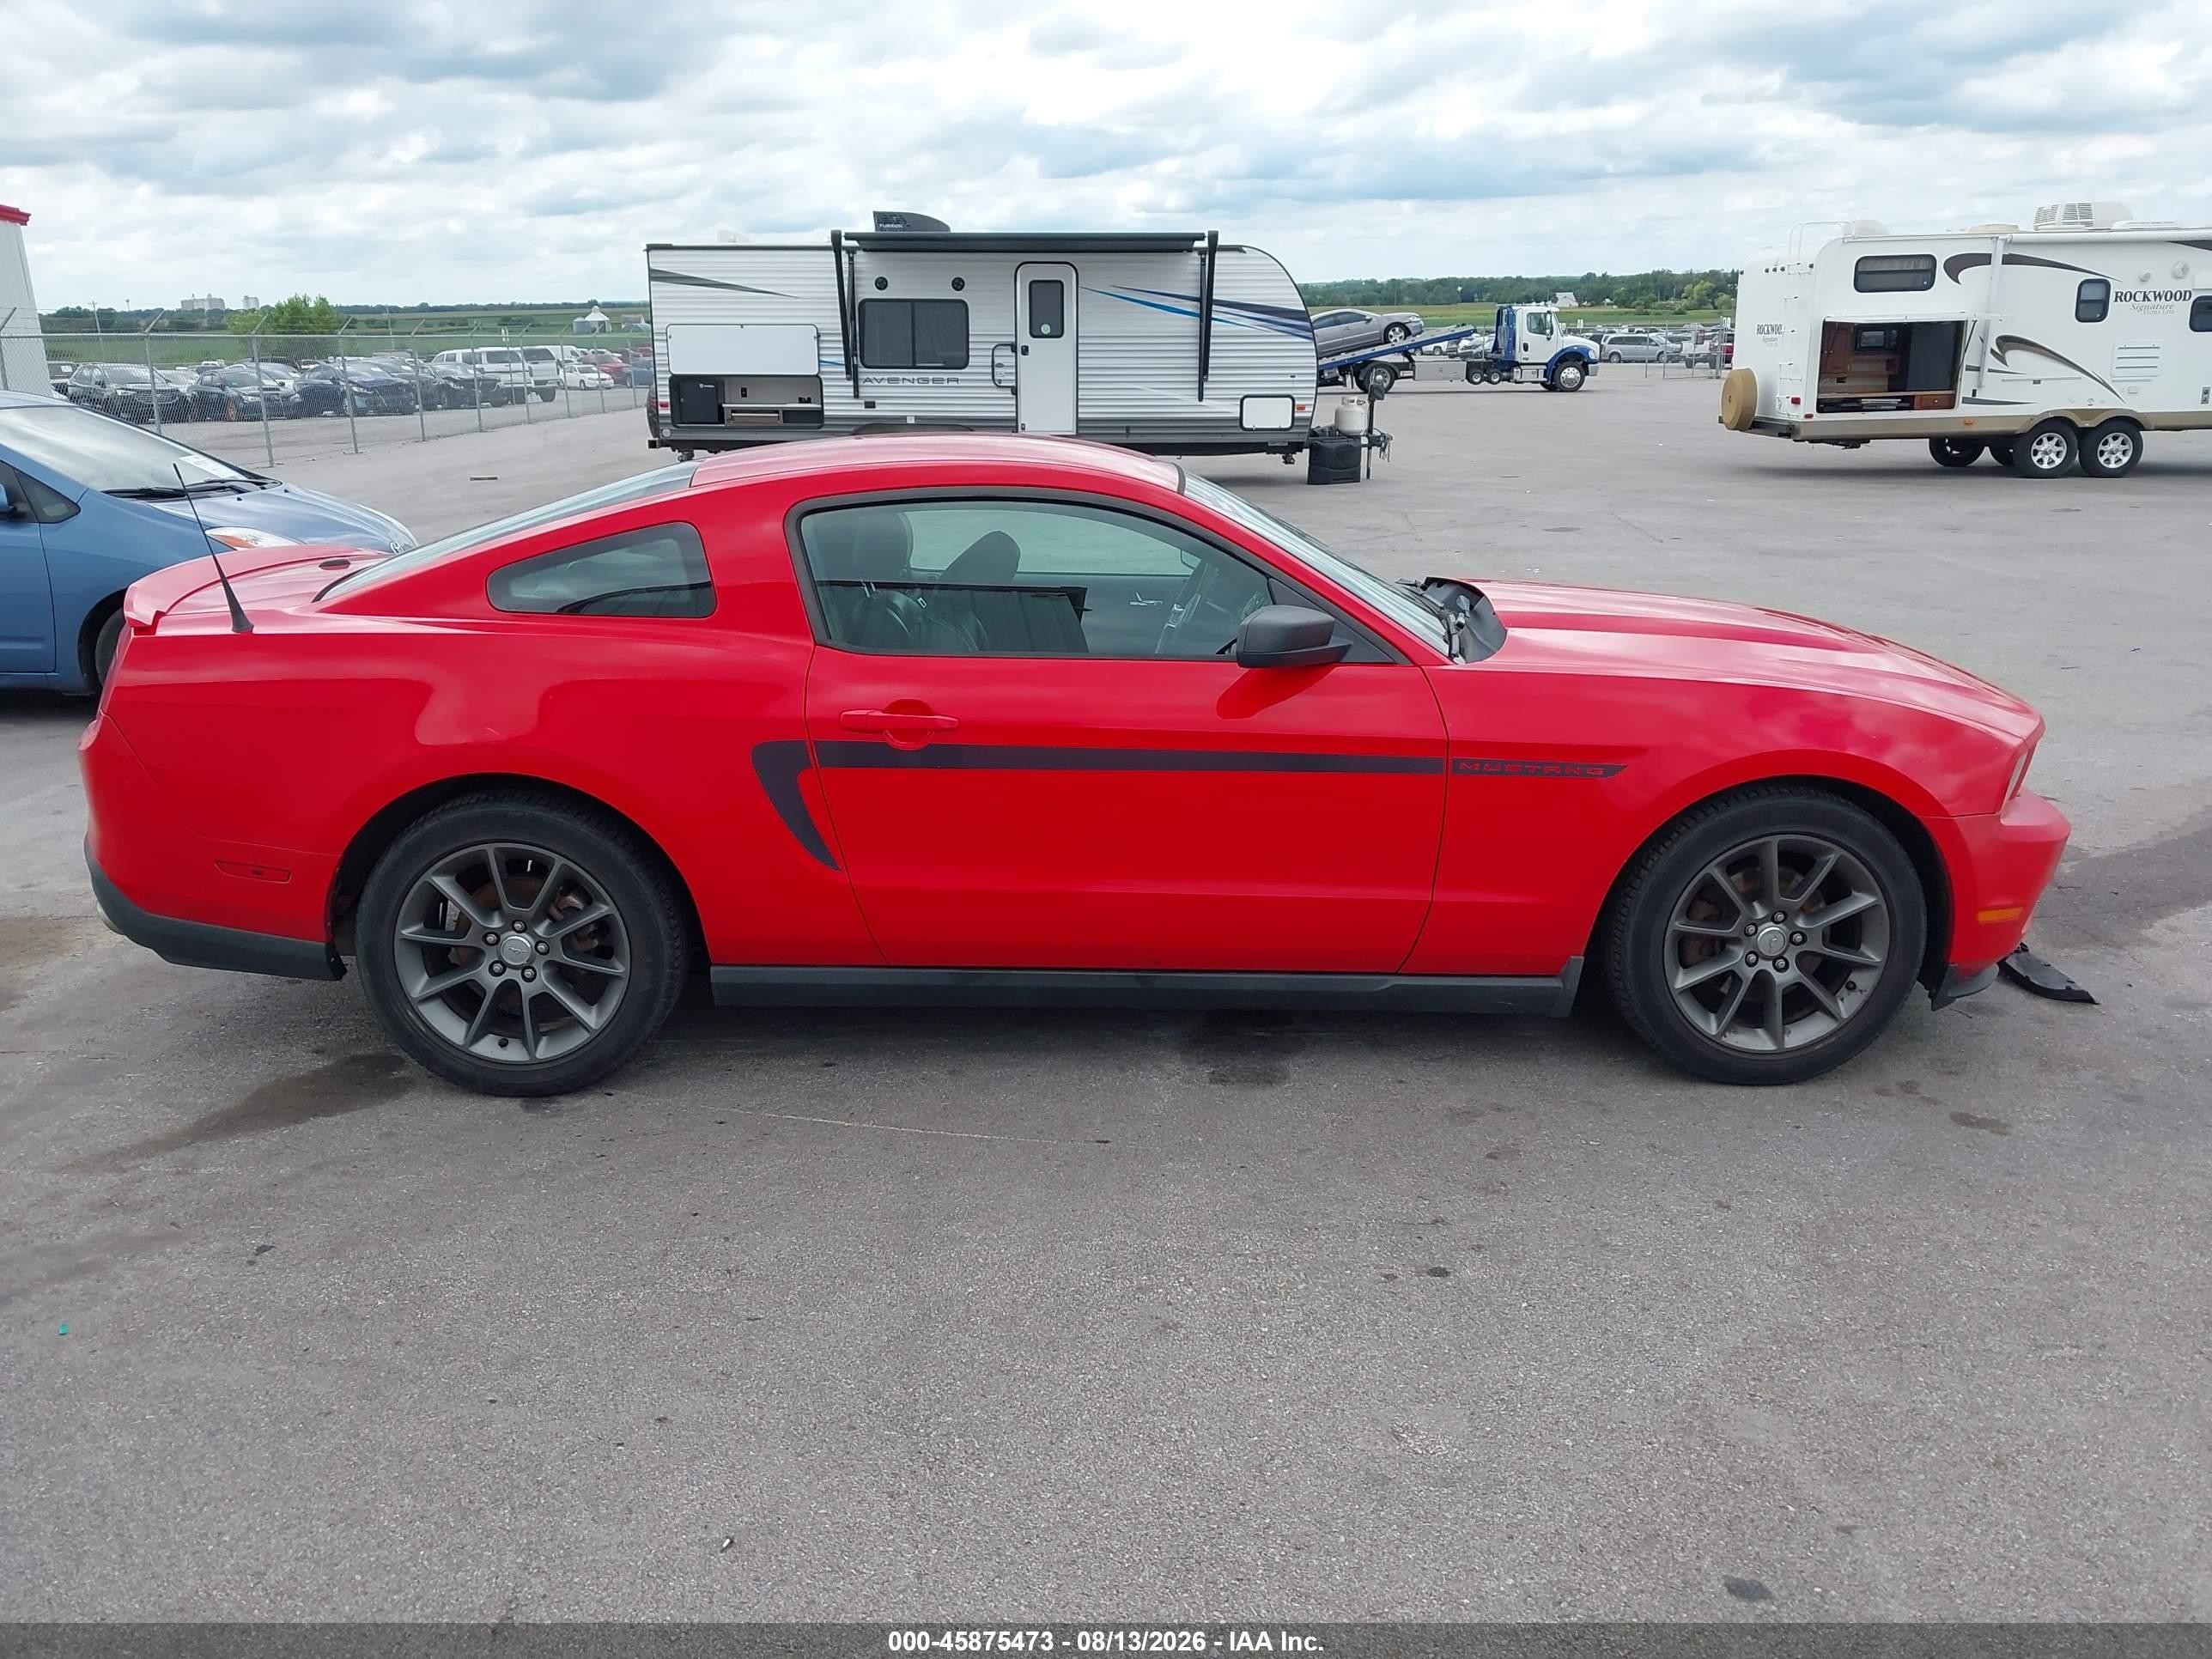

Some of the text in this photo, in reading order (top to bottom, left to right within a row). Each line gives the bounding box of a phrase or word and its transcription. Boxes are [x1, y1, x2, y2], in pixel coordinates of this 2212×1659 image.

[2113, 289, 2192, 302] ROCKWOOD
[2130, 303, 2175, 313] Signature
[1459, 762, 1604, 775] MUSTANG
